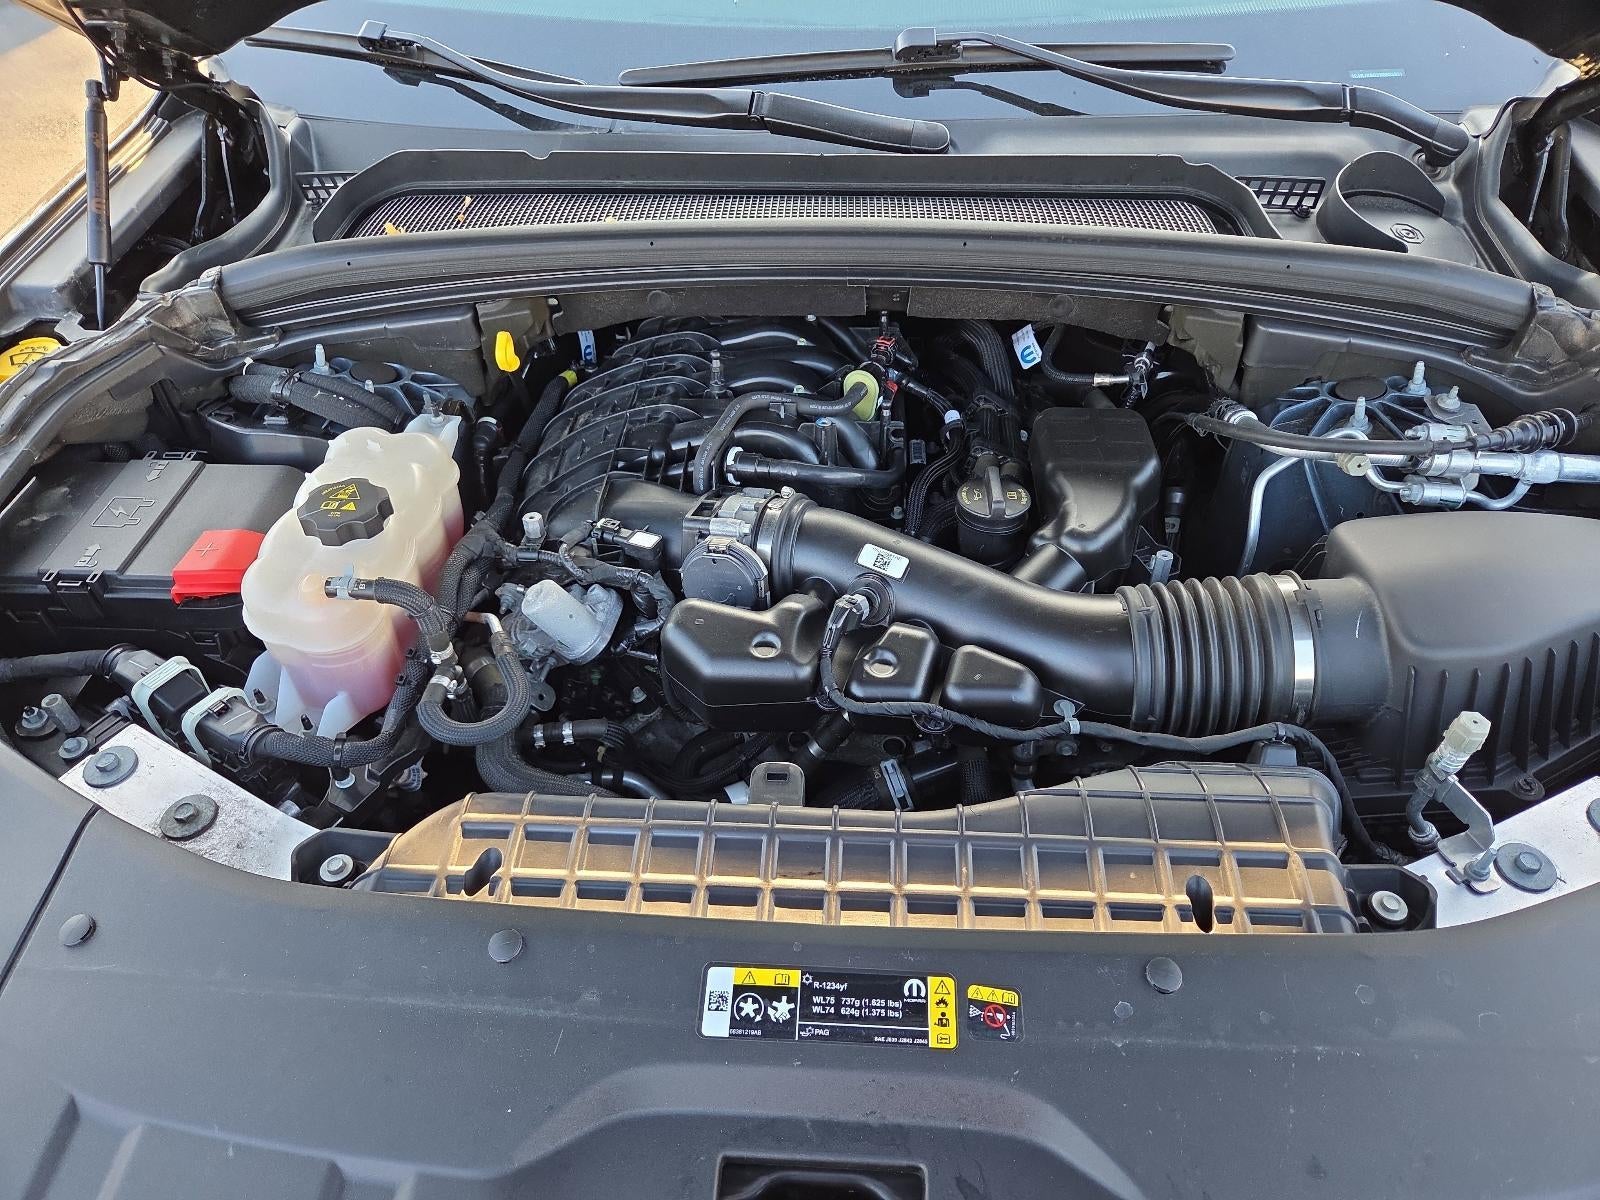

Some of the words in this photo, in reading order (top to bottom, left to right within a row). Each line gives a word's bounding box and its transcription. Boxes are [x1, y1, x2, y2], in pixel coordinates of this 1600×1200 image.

[813, 981, 848, 992] R-1234yf
[812, 996, 835, 1005] WL75
[841, 998, 860, 1008] 737g
[861, 998, 886, 1009] (1.625
[887, 1000, 903, 1010] lbs)
[812, 1006, 835, 1014] WL74
[840, 1007, 860, 1017] 624g
[861, 1008, 886, 1018] (1.375
[887, 1009, 903, 1019] lbs)
[814, 1028, 830, 1036] PAG
